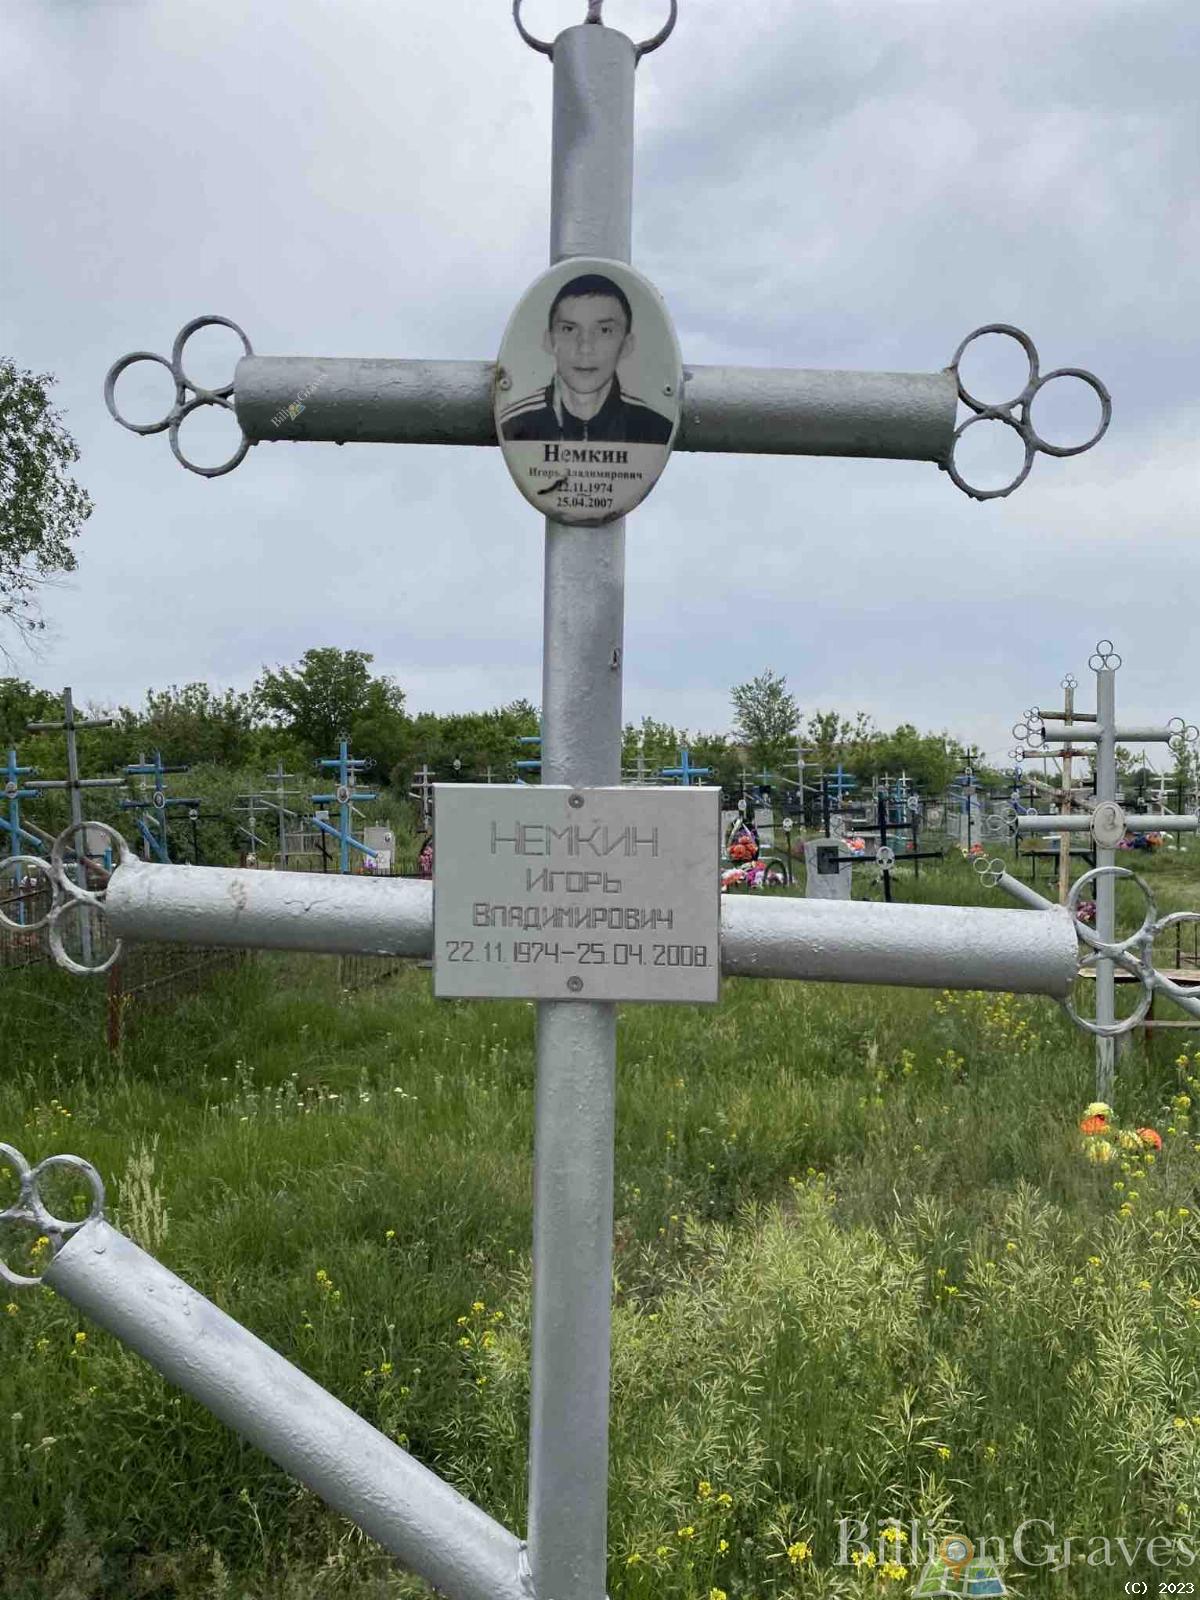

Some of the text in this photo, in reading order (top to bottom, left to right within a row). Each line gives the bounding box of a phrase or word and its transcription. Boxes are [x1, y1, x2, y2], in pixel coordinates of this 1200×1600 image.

[544, 444, 628, 464] Немкин
[529, 467, 560, 479] Игорь
[557, 497, 613, 508] 25.04.2007
[491, 820, 659, 857] НЕМКИН
[526, 868, 622, 894] ИГОРЬ
[472, 903, 674, 930] ВЛАДИМИРОВИЧ
